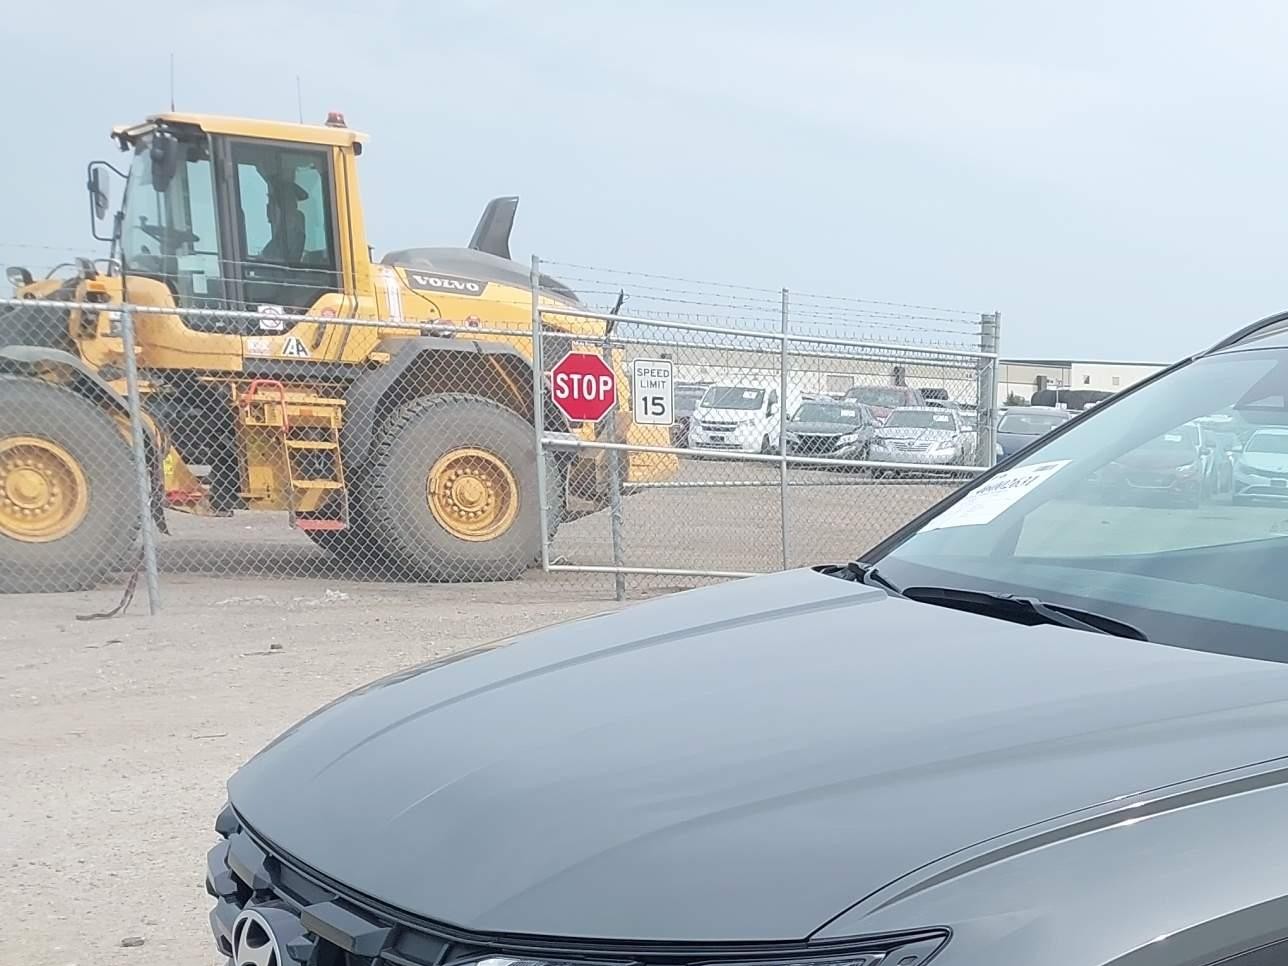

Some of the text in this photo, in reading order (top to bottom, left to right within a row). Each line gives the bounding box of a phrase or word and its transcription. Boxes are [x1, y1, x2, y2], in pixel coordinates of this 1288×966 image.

[412, 275, 480, 291] VOLVO
[637, 368, 670, 378] SPEED
[555, 373, 613, 400] STOP
[640, 380, 667, 389] LIMIT
[641, 396, 666, 416] 15
